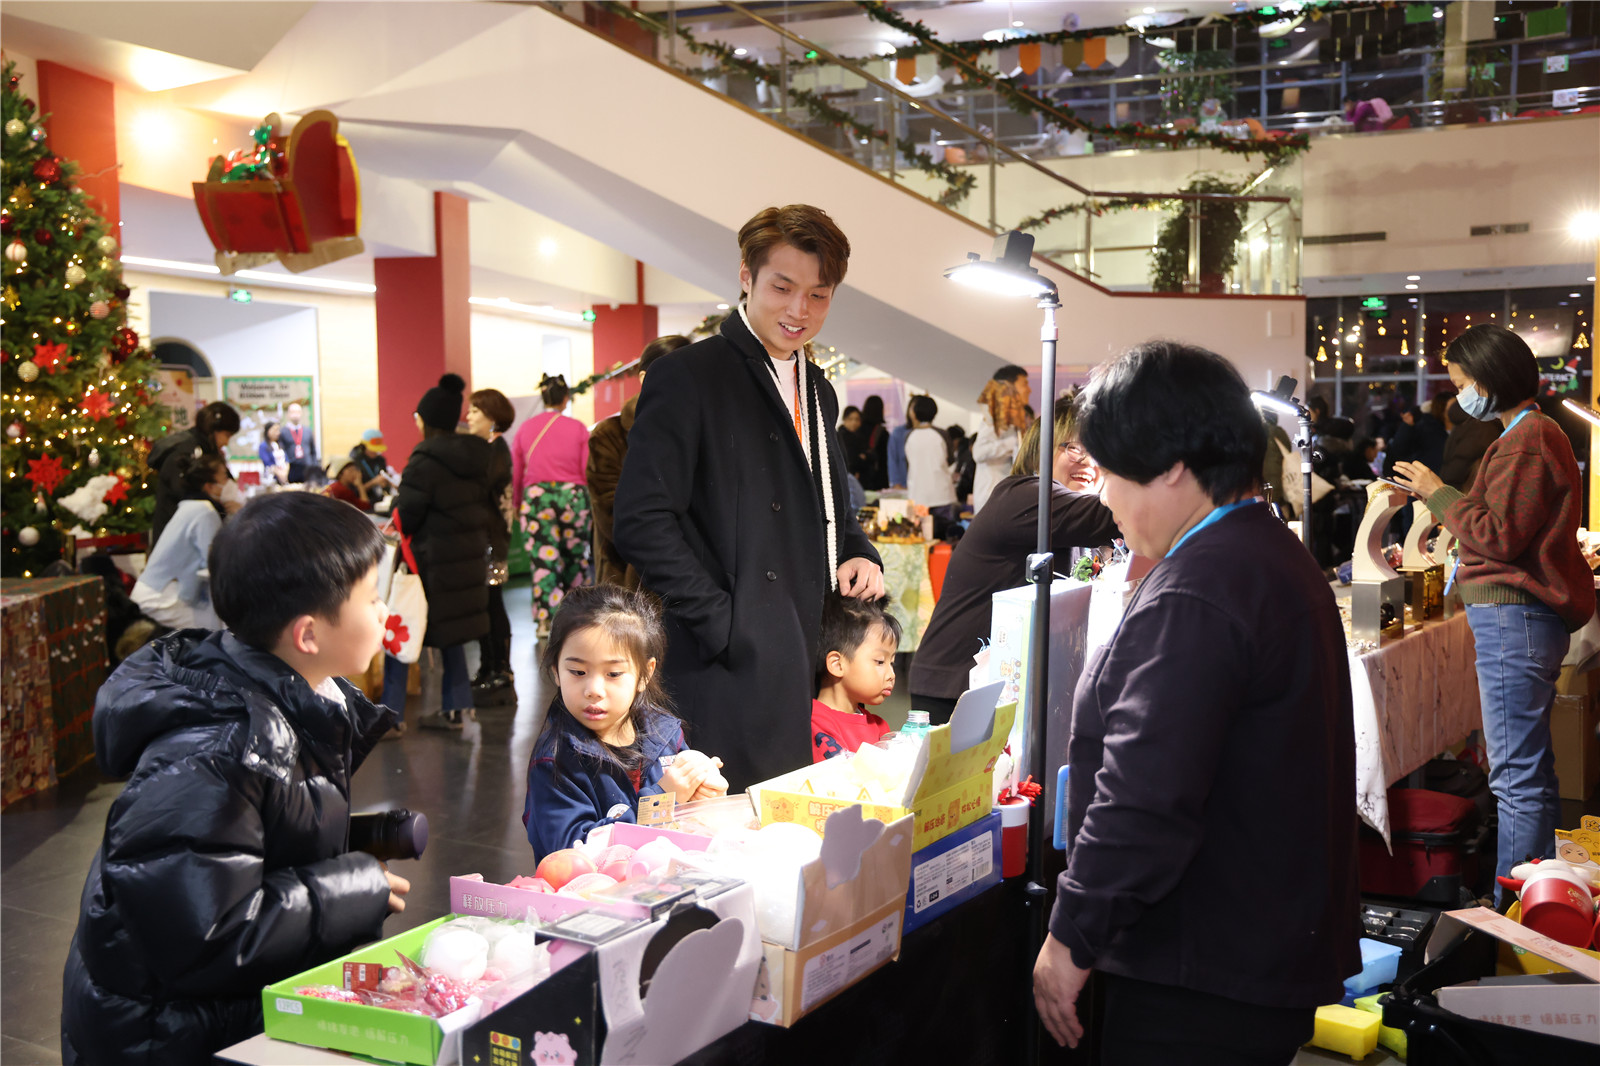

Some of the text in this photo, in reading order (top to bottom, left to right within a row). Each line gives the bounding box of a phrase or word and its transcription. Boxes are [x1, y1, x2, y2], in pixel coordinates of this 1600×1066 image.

[815, 732, 843, 760] 3
[463, 893, 508, 916] 释放压力
